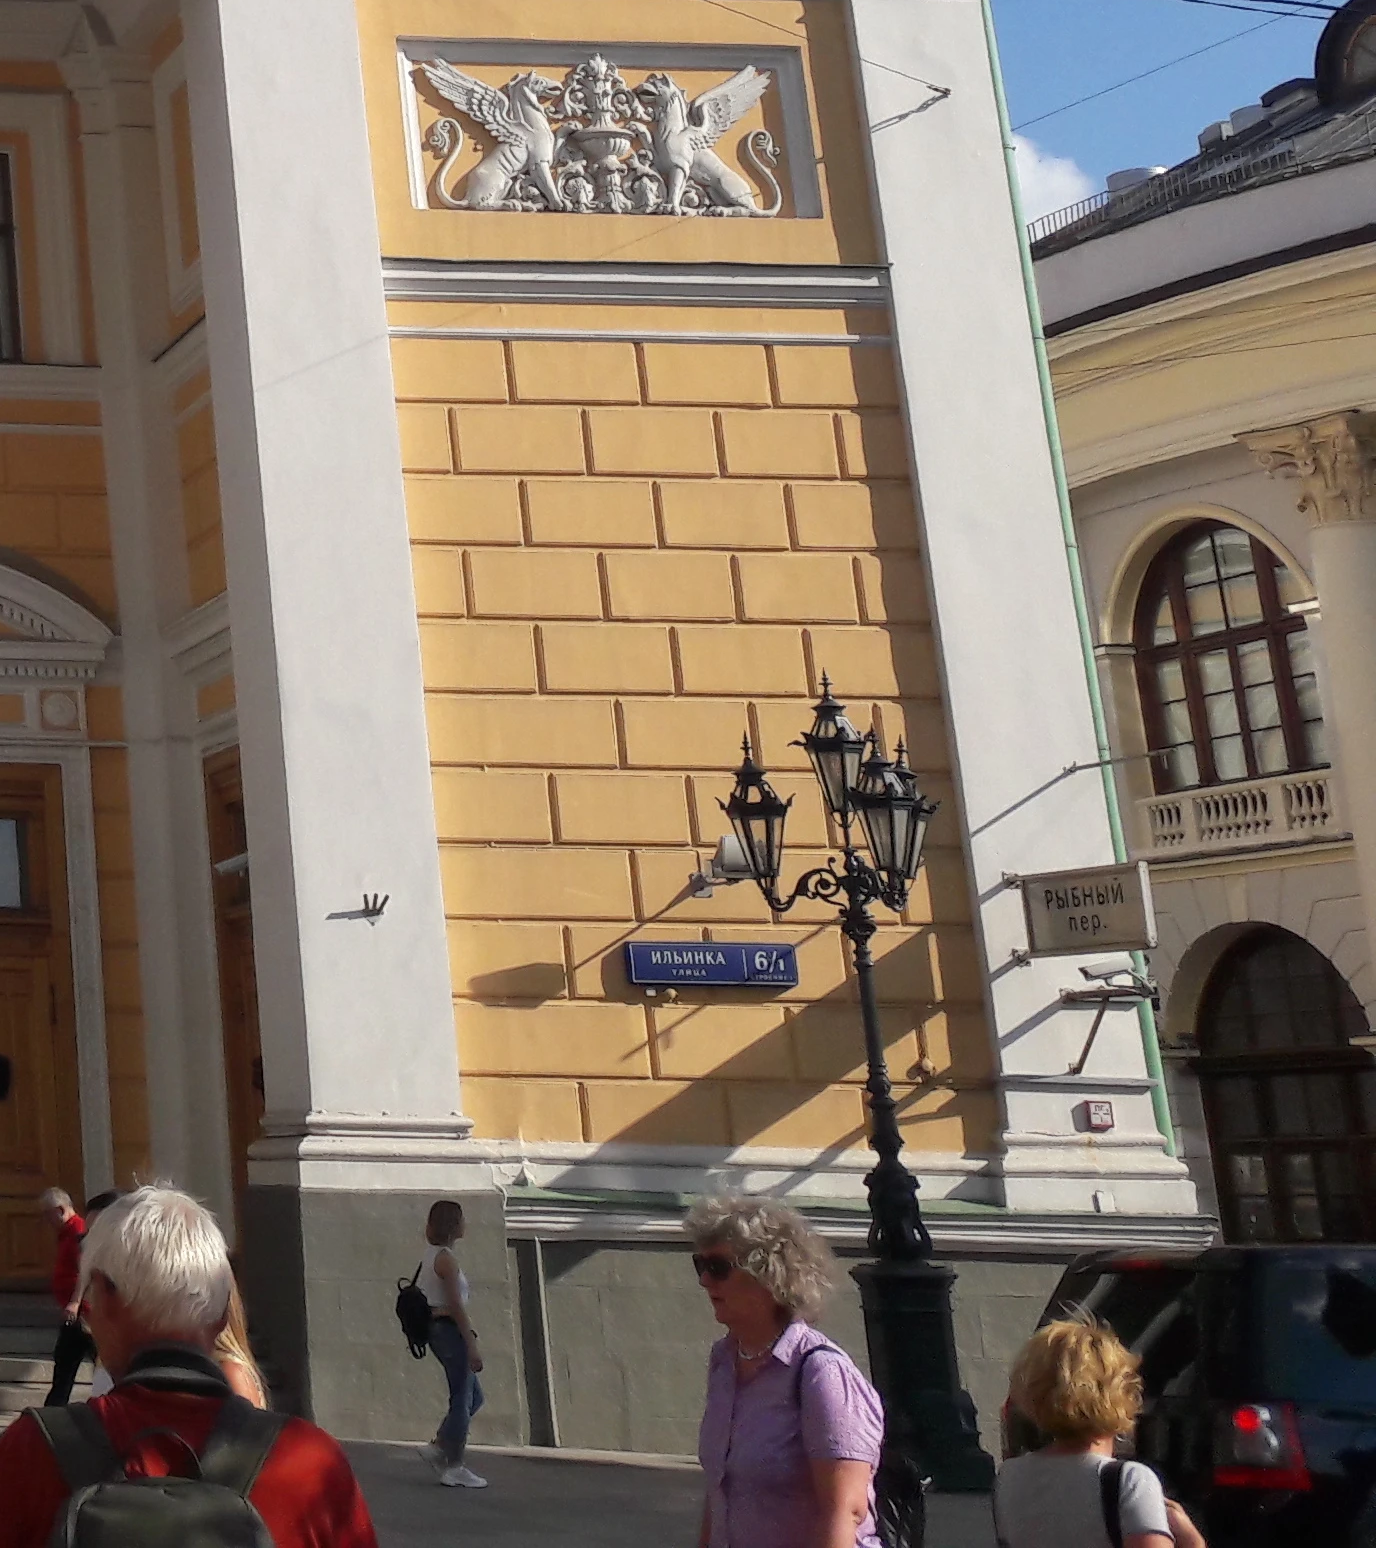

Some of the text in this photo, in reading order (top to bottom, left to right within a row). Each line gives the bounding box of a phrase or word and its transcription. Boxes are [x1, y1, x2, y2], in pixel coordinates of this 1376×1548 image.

[1044, 878, 1124, 909] РЫБНЫЙ
[1068, 914, 1108, 935] пер.
[651, 950, 727, 965] ИЛЬИНКА
[754, 950, 786, 973] 6/1
